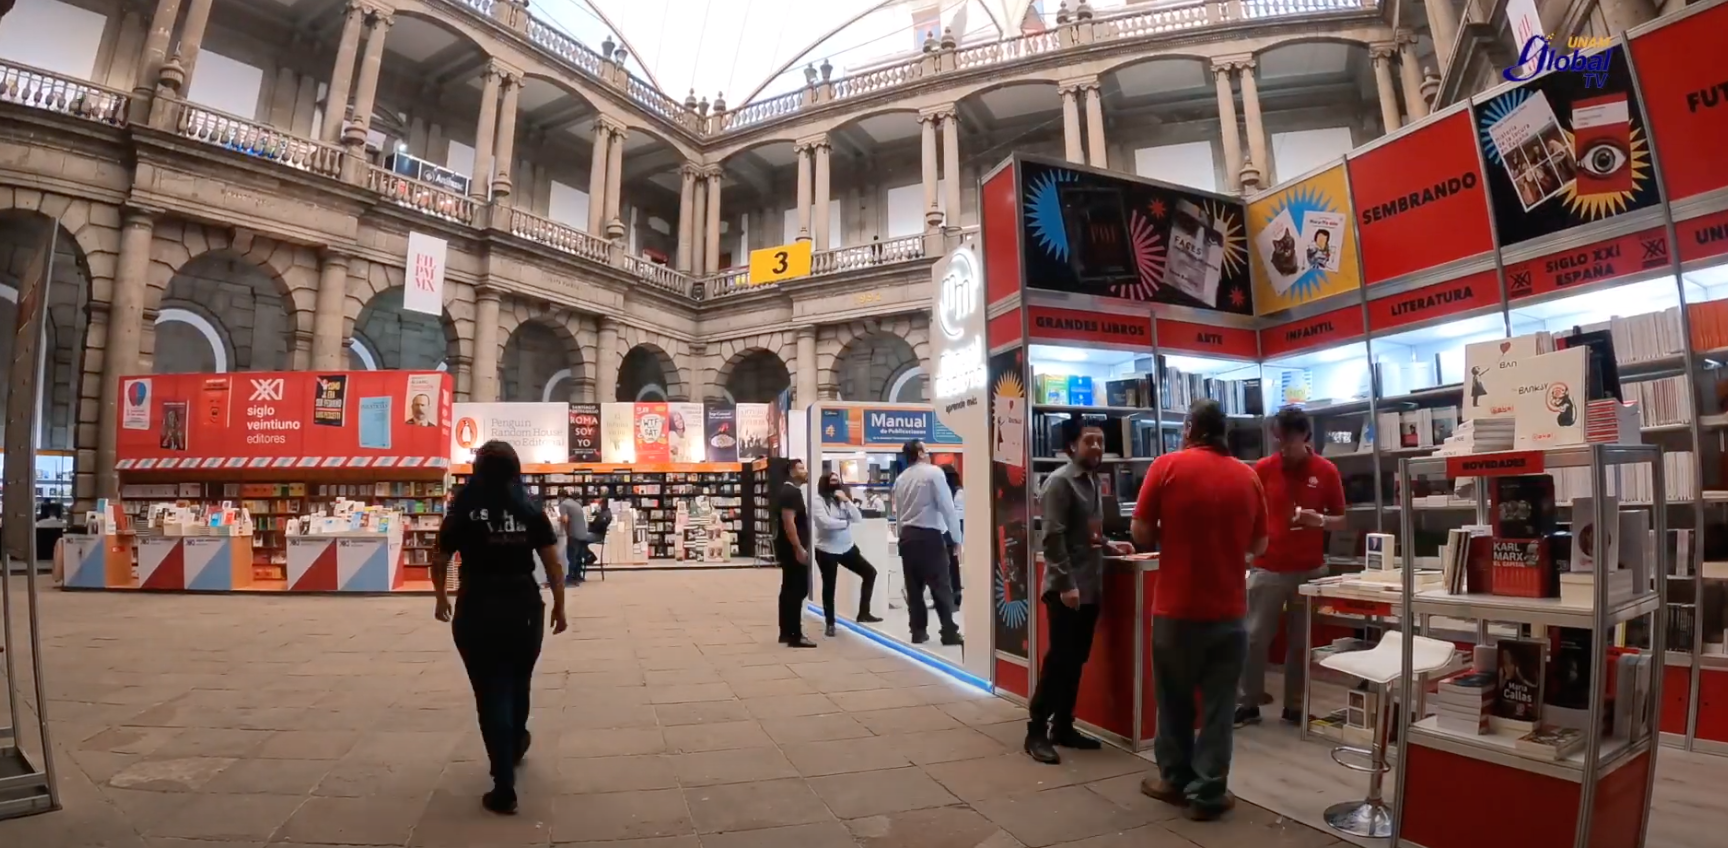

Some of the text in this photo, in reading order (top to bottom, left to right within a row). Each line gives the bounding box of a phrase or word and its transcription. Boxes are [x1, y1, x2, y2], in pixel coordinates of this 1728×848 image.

[1362, 172, 1477, 225] SEMBRANDO
[1175, 236, 1202, 256] FACES
[772, 252, 788, 274] 3
[1546, 244, 1621, 273] SIGLO XXI
[1556, 263, 1615, 287] ESPAÑA
[1390, 286, 1473, 316] LITERATURA
[1036, 316, 1145, 336] GRANDES LIBROS
[1286, 321, 1334, 342] INFANTIL
[1197, 333, 1223, 345] ARTE
[247, 404, 275, 418] siglo
[247, 419, 301, 430] veintiuno
[490, 418, 532, 429] Penguin
[570, 416, 598, 424] ROMA
[871, 412, 927, 428] Manual
[490, 427, 563, 437] Random House
[575, 427, 593, 436] SOY
[246, 433, 286, 444] editores
[577, 439, 591, 447] YO
[1462, 458, 1526, 470] NOVEDADES
[1493, 542, 1520, 552] KARL
[1493, 552, 1523, 562] MARX
[1503, 688, 1533, 703] Callas
